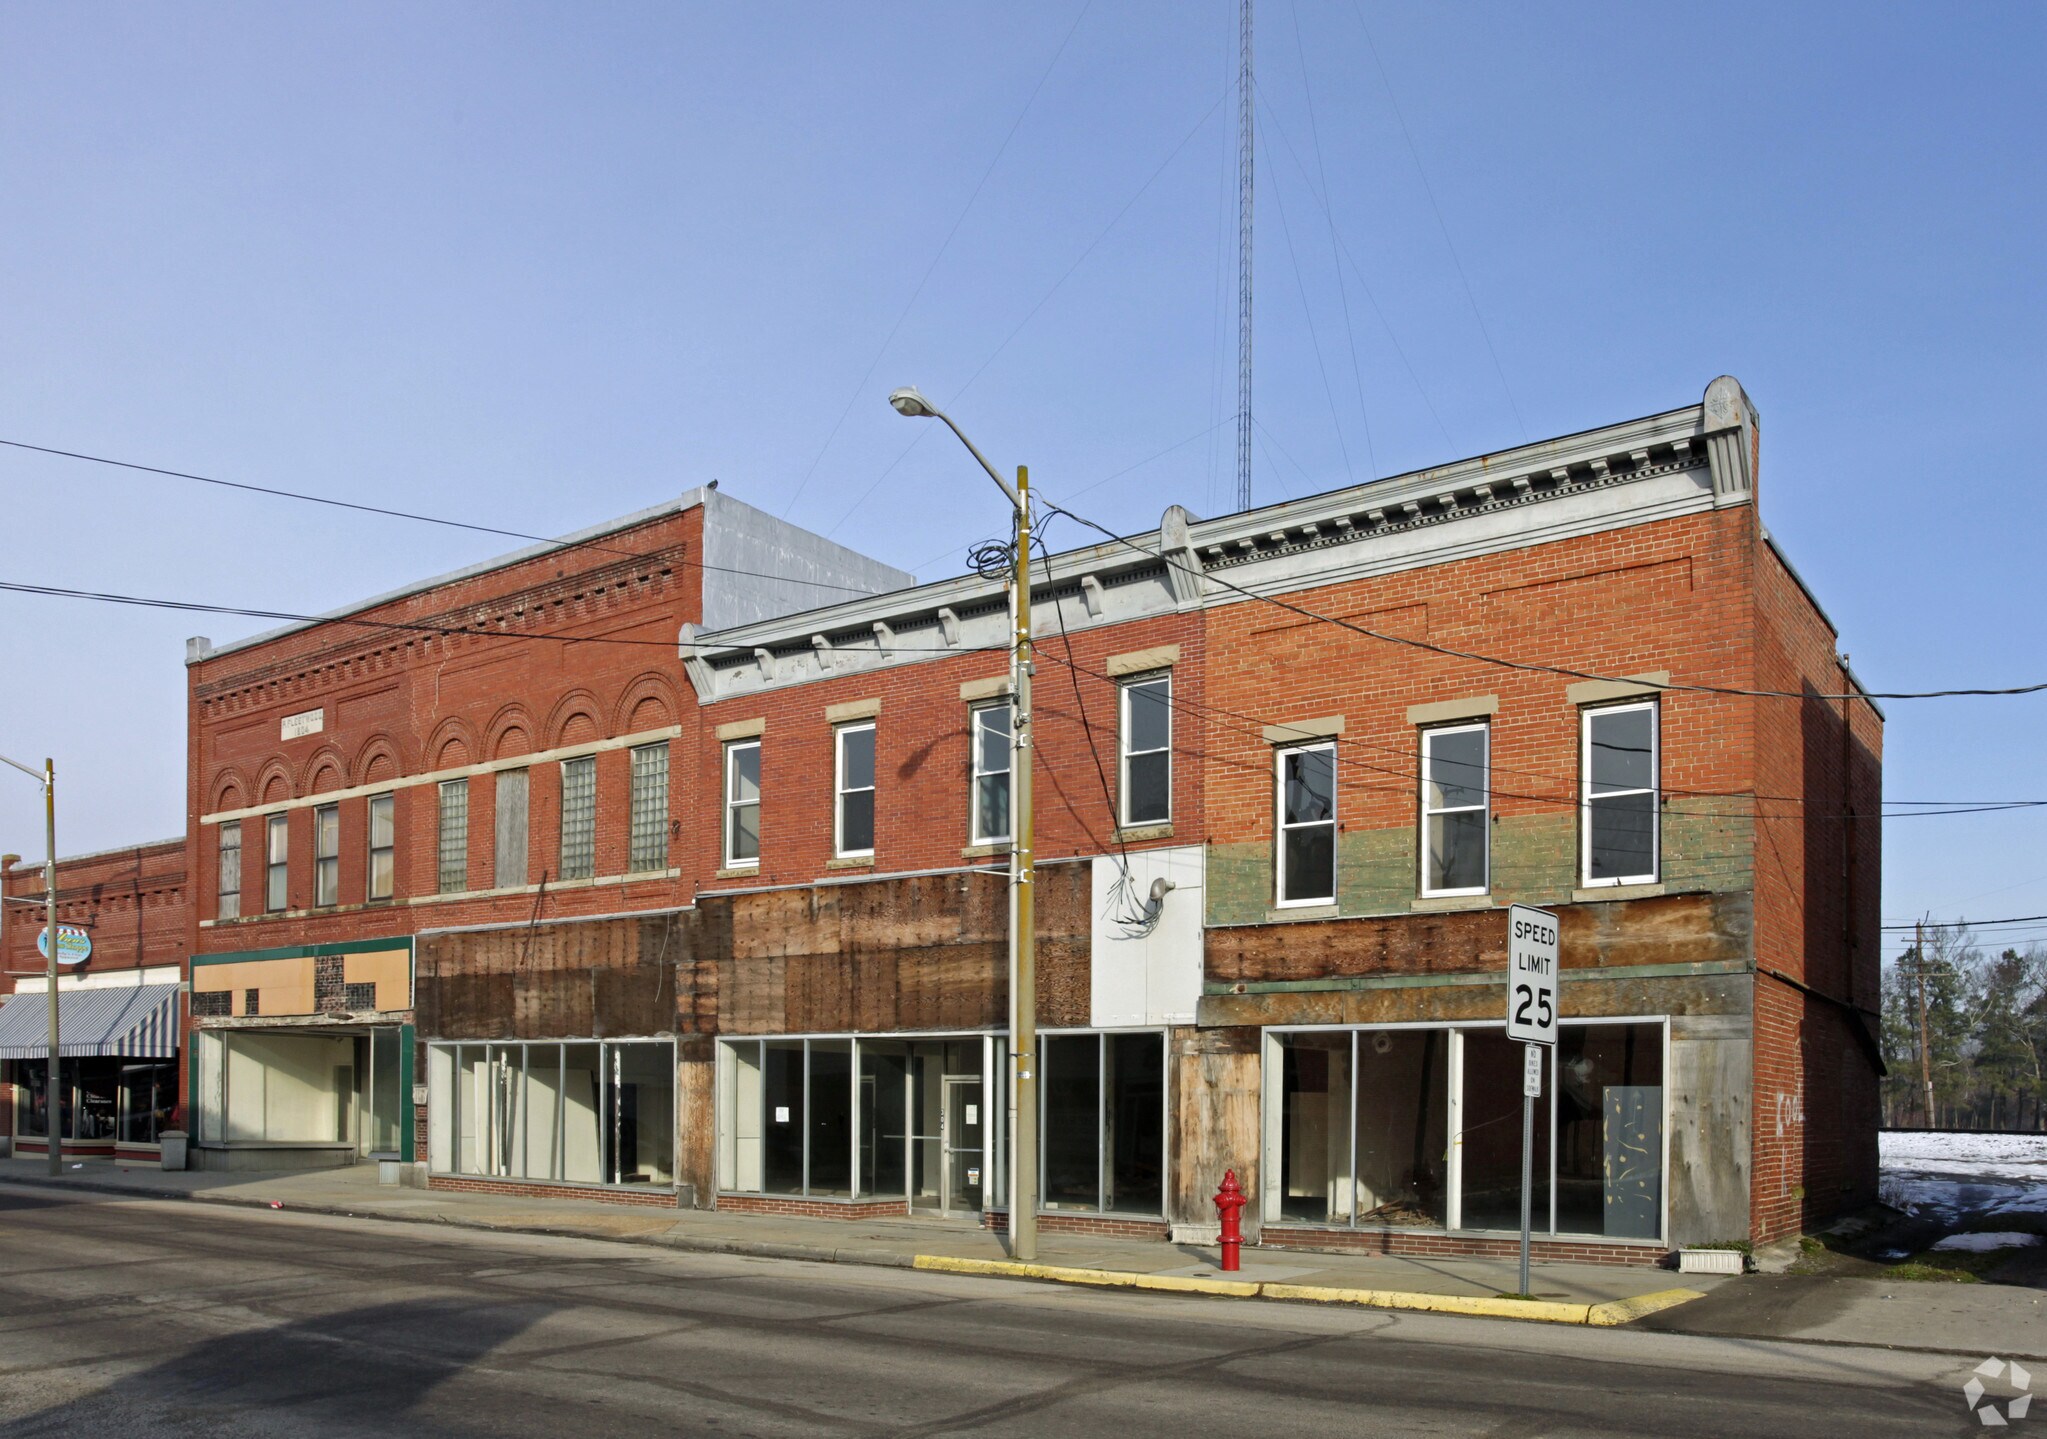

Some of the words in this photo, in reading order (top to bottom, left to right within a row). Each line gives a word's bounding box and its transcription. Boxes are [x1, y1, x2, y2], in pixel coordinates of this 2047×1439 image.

[1514, 920, 1556, 946] SPEED
[1518, 952, 1551, 976] LIMIT
[1515, 984, 1552, 1029] 25
[1530, 1049, 1536, 1059] NO
